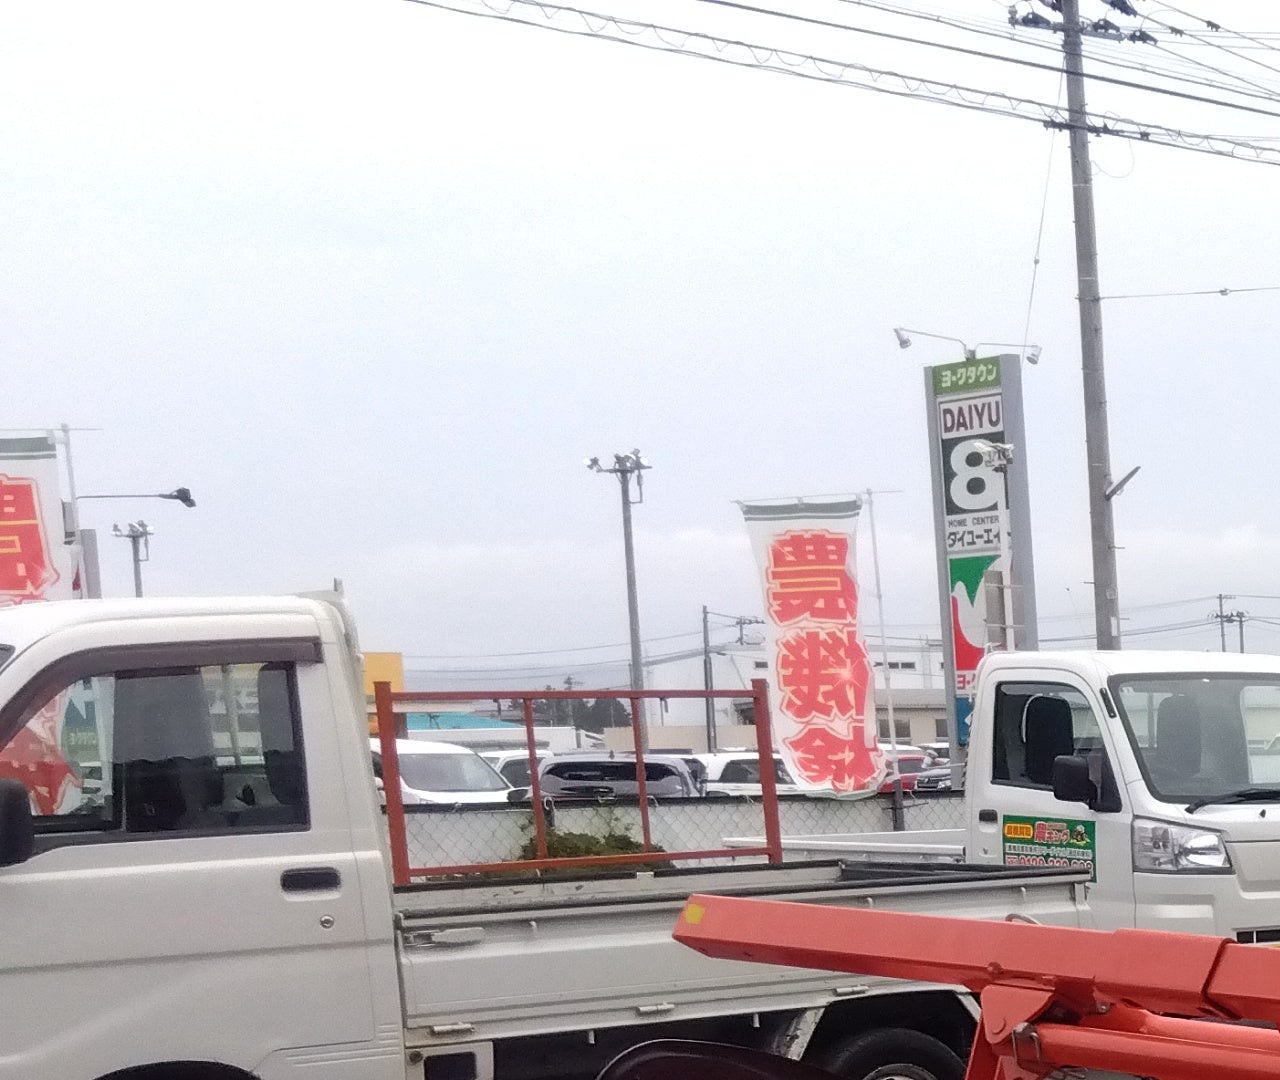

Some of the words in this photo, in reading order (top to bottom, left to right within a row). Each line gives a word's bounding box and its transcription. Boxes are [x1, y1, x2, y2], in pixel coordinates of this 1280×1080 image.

[940, 363, 998, 388] ヨークタウン
[941, 400, 1001, 434] DAIYU
[949, 438, 1003, 511] 8
[948, 517, 968, 529] HOME
[972, 514, 1000, 526] CENTER
[947, 527, 1011, 549] ダイユーエイ
